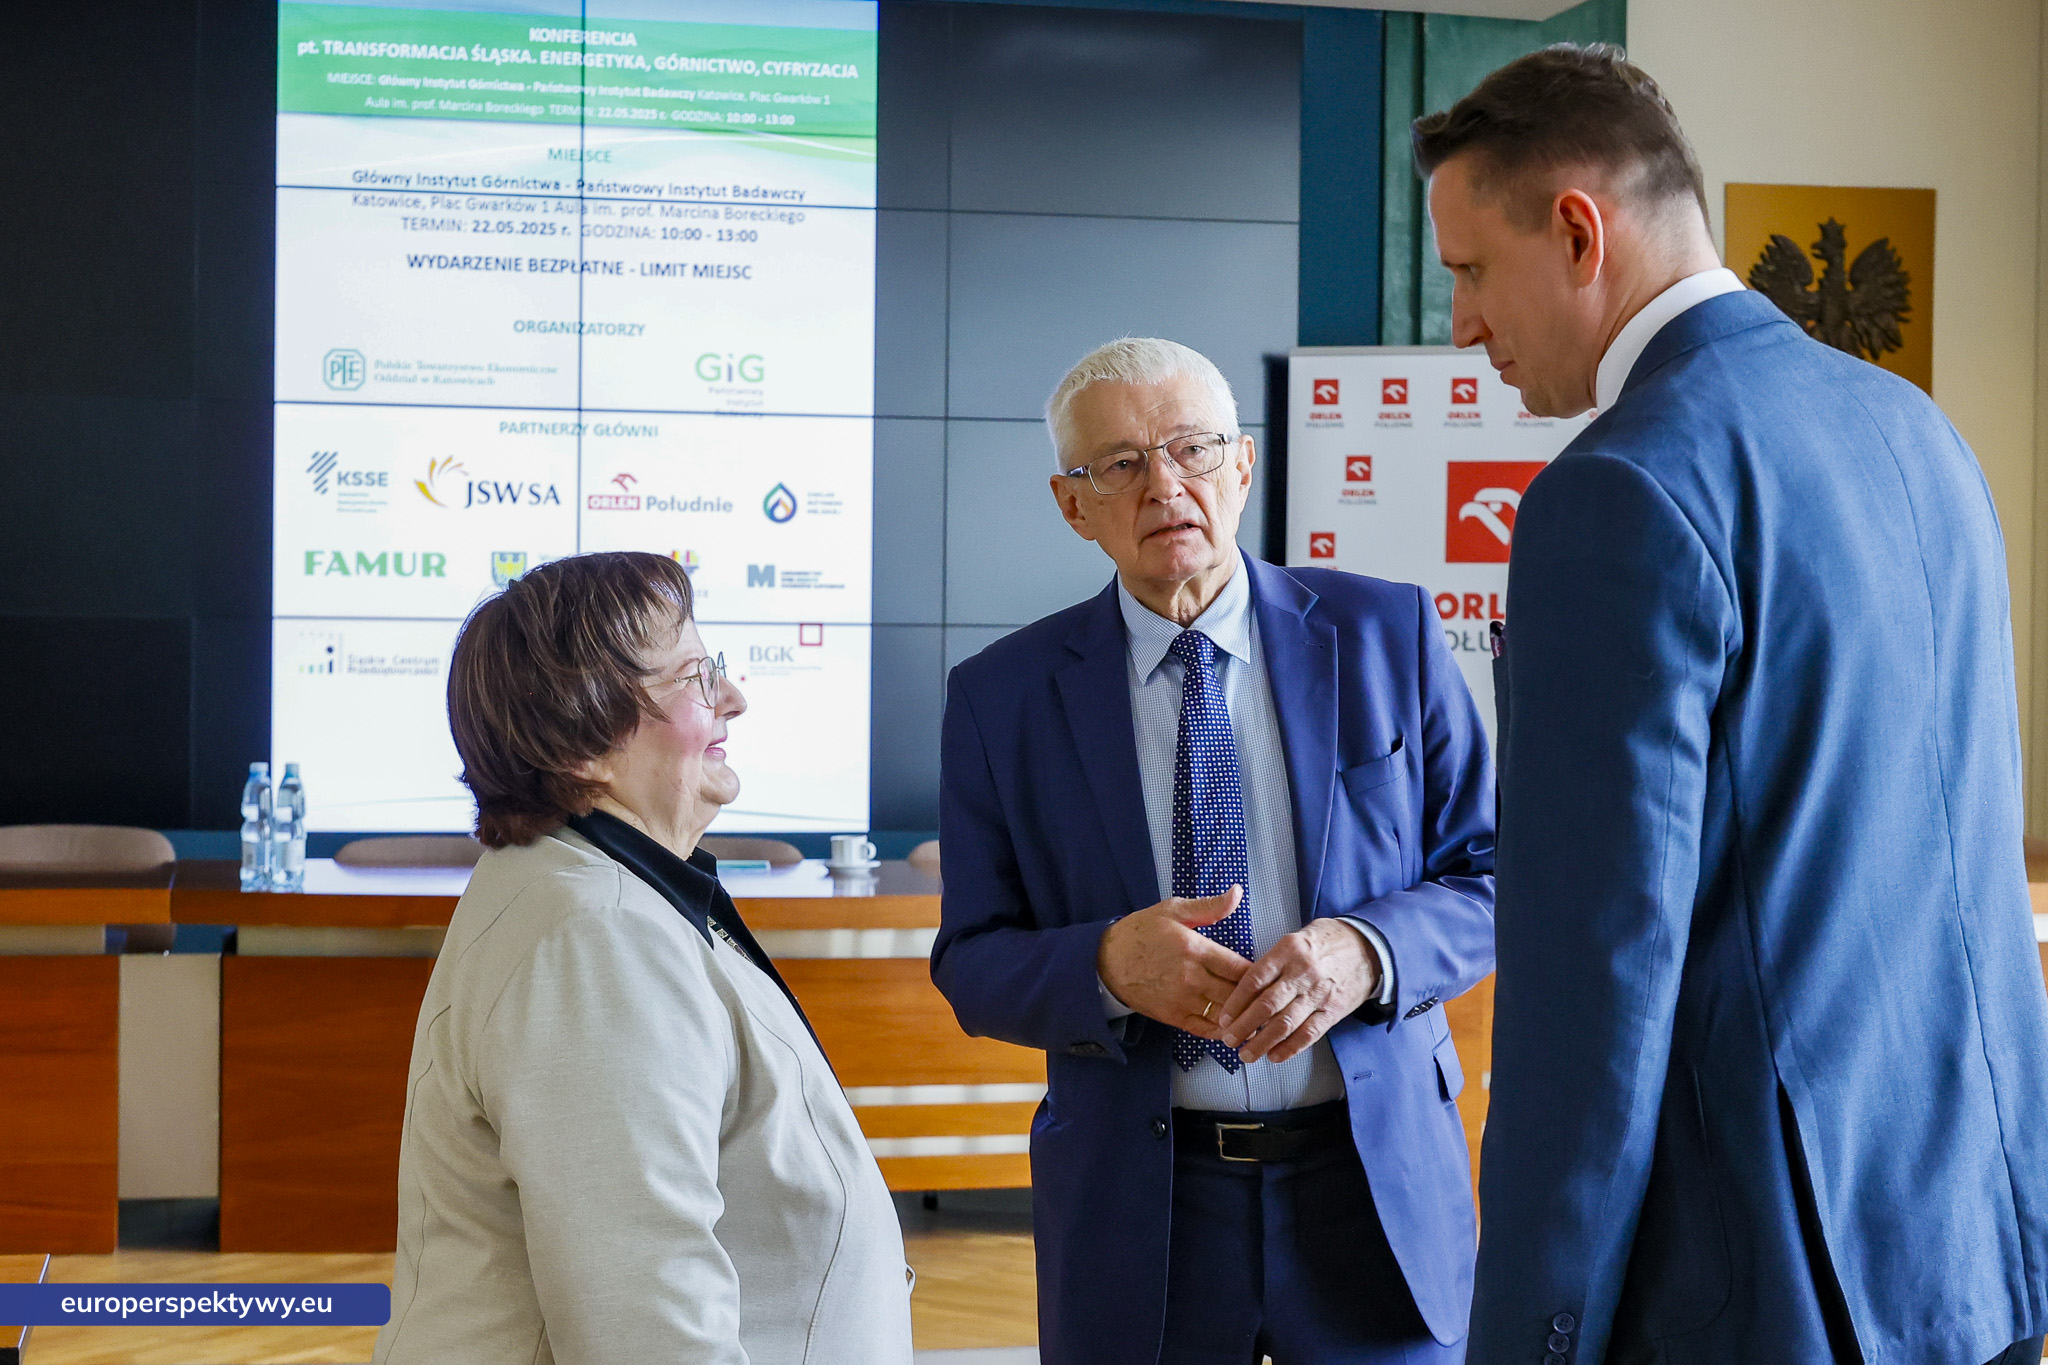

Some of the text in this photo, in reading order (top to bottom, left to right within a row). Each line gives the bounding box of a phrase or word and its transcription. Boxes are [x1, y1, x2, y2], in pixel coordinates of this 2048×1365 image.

[529, 27, 638, 47] KONFERENCJA
[298, 40, 859, 79] pt. TRANSFORMACJA ŚLĄSKA. ENERGETYKA, GÓRNICTWO, CYFRYZACJA
[378, 75, 421, 89] Główny
[643, 86, 696, 101] Badawczy
[547, 147, 613, 163] MIEJSCE
[352, 169, 413, 187] Główny
[416, 173, 476, 189] Instytut
[481, 175, 561, 190] Górnictwa
[576, 178, 663, 197] Państwowy
[667, 182, 728, 199] Instytut
[732, 184, 806, 201] Badawczy
[352, 192, 806, 225] Katowice, Plac Gwarków 1 Aula im. prof. Marcina Boreckiego
[401, 216, 467, 232] TERMIN:
[472, 219, 557, 236] 22.05.2025
[561, 226, 571, 236] r.
[580, 223, 656, 239] GODZINA:
[661, 226, 702, 240] 10:00
[717, 229, 758, 242] 13:00
[407, 253, 523, 272] WYDARZENIE
[528, 257, 624, 275] BEZPŁATNE
[640, 261, 688, 277] LIMIT
[692, 263, 752, 280] MIEJSC
[513, 319, 646, 337] ORGANIZATORZY
[695, 352, 765, 383] GiG
[499, 421, 659, 438] PARTNERZY GŁÓWNI
[337, 471, 389, 487] KSSE
[464, 481, 562, 509] JSW SA
[646, 495, 733, 513] Południe
[304, 550, 448, 578] FAMUR
[1434, 593, 1505, 619] ORL
[749, 645, 795, 663] BGK
